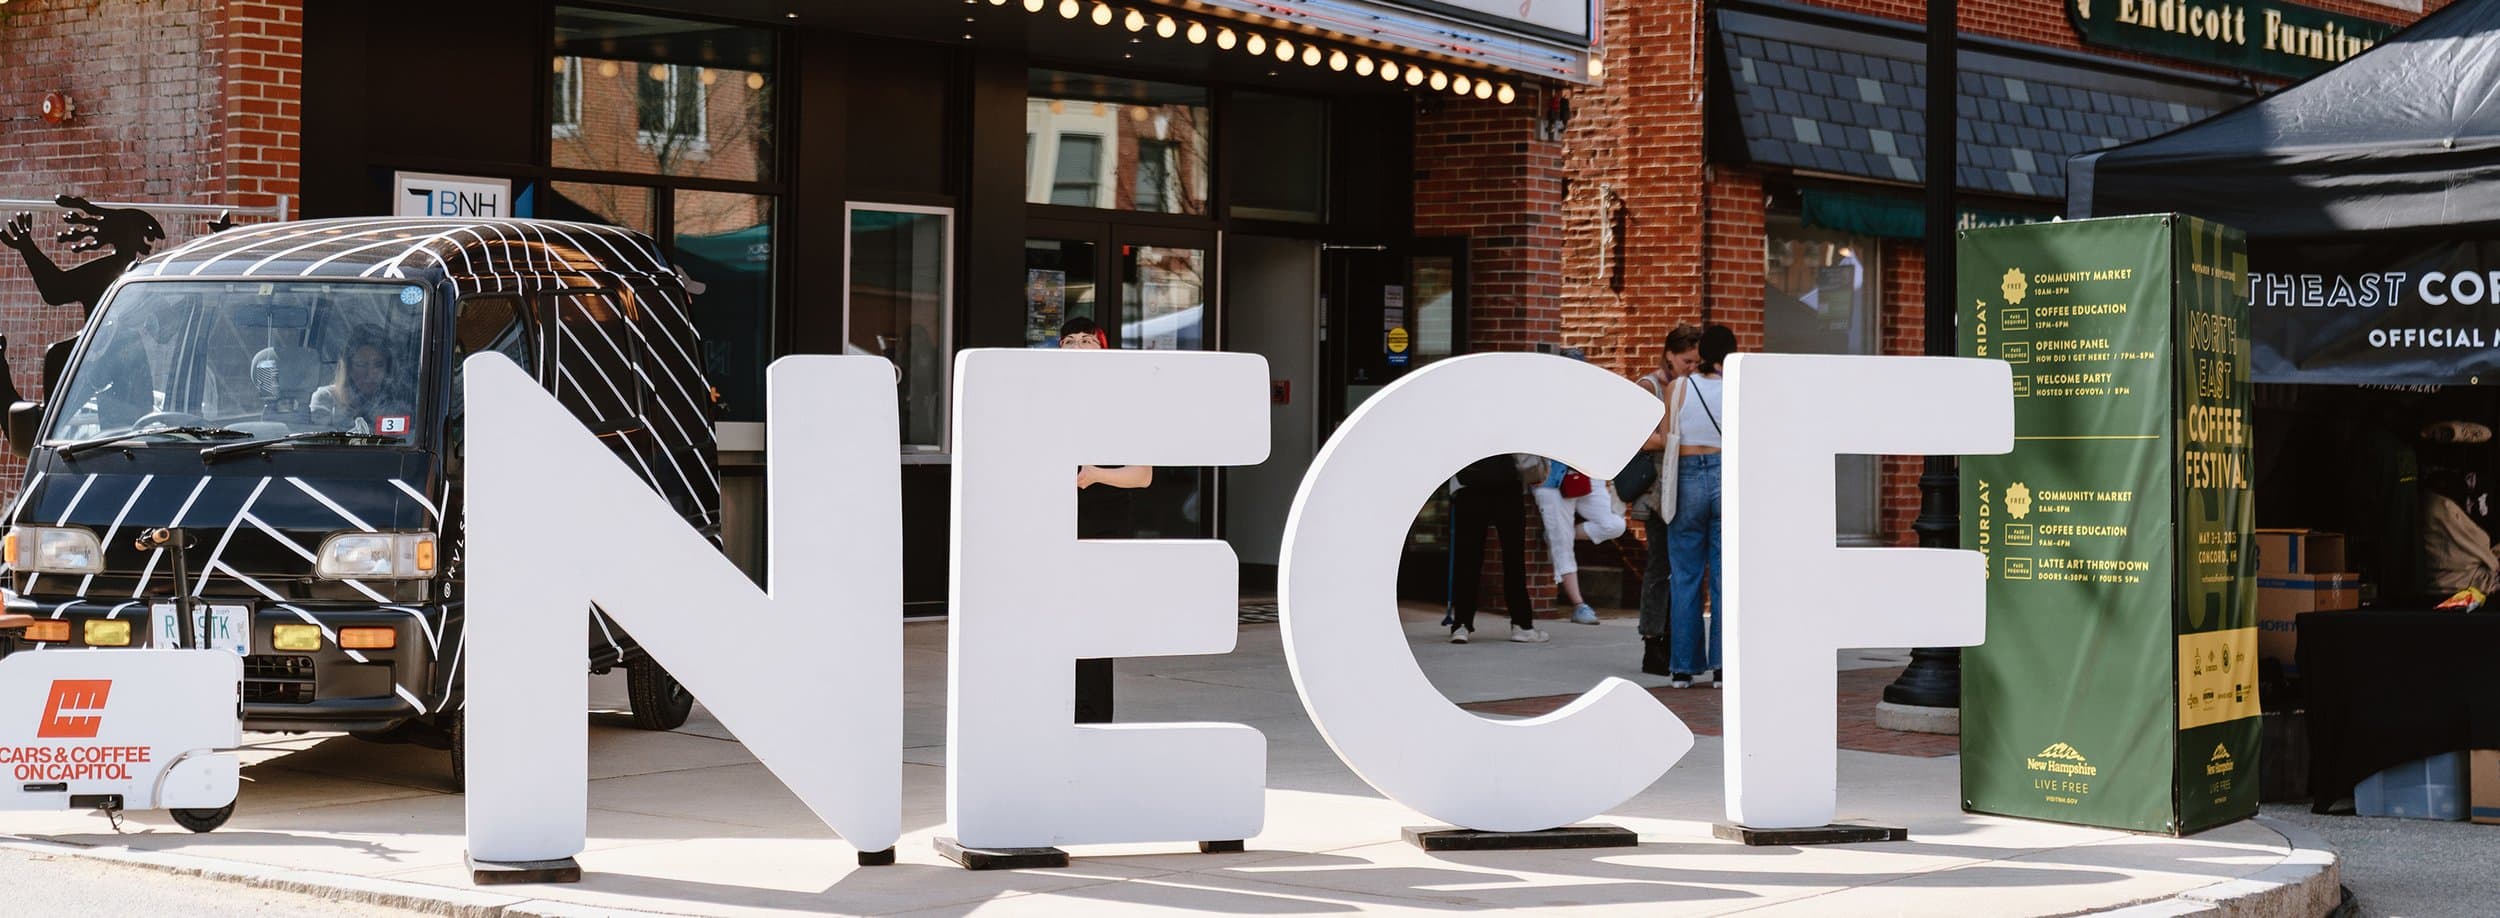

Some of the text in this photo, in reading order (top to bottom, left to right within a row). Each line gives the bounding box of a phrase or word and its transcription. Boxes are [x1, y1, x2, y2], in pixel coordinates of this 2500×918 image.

[2115, 0, 2247, 46] Endicott
[440, 190, 496, 217] BNH
[2034, 269, 2132, 284] COMMUNITY MARKET
[2035, 303, 2127, 317] COFFEE EDUCATION
[1976, 298, 1987, 357] RIDAY
[2190, 309, 2237, 356] NORTH
[2036, 339, 2110, 351] OPENING PANEL
[2368, 328, 2485, 348] OFFICIAL
[2036, 354, 2051, 363] HOW
[2053, 354, 2067, 362] DID
[2072, 353, 2087, 362] GET
[2036, 373, 2112, 385] WELCOME PARTY
[2199, 358, 2231, 400] EAST
[2036, 388, 2063, 397] HOSTED
[2065, 388, 2073, 396] BY
[386, 419, 394, 430] 3
[2188, 404, 2242, 444] COFFEE
[2185, 451, 2248, 490] FESTIVAL
[2010, 497, 2025, 505] FREE
[2038, 490, 2133, 502] COMMUNITY MARKET
[2039, 524, 2127, 537] COFFEE EDUCATION
[2038, 558, 2149, 572] LATTE ART THROWDOWN
[2038, 573, 2062, 581] DOORS
[0, 746, 151, 763] CARS & COFFEE
[14, 763, 132, 780] ON CAPITOL
[2027, 758, 2097, 777] New Hampshire
[2035, 778, 2088, 794] LIVE FREE
